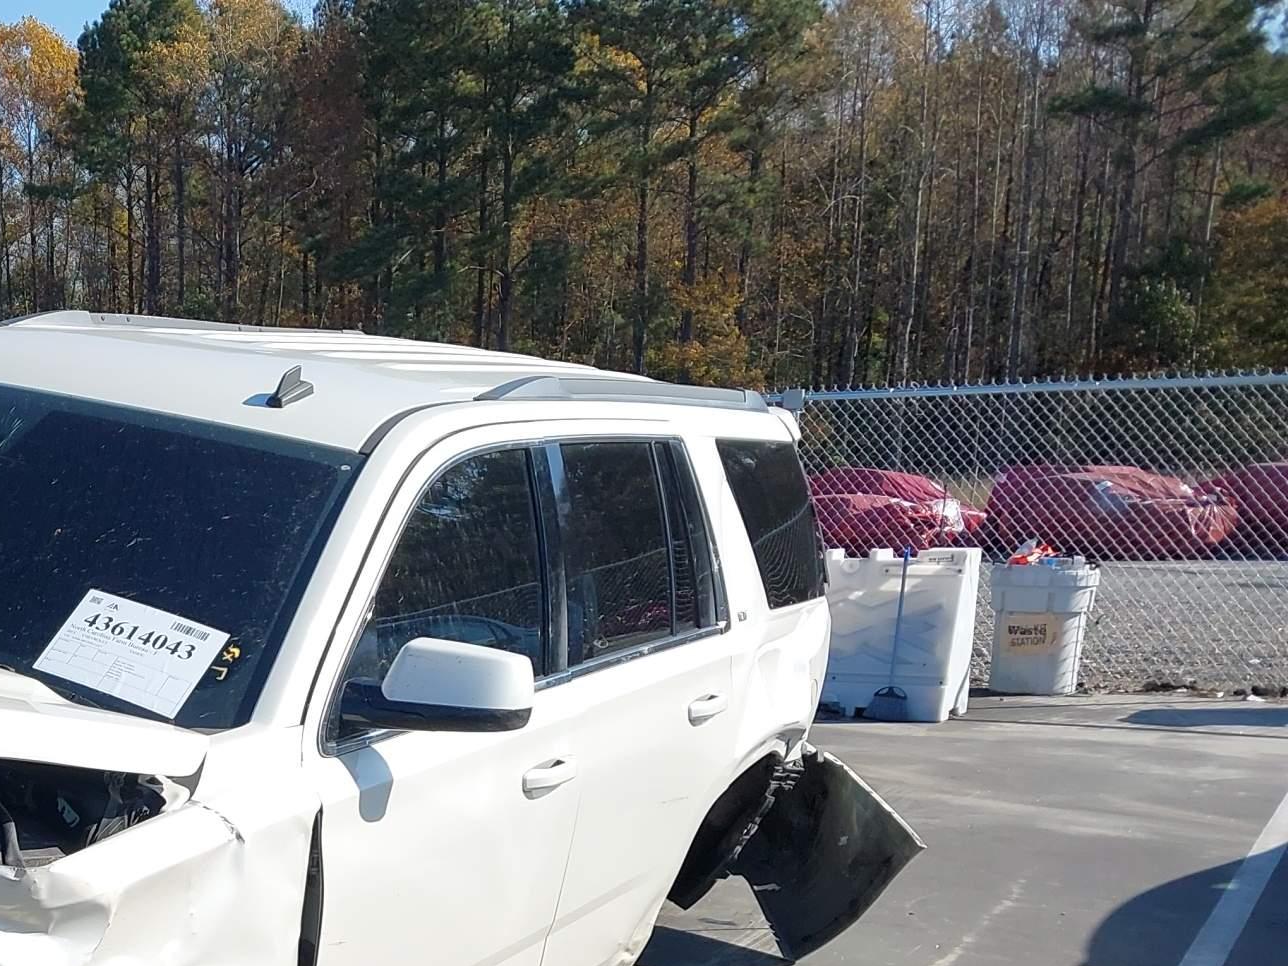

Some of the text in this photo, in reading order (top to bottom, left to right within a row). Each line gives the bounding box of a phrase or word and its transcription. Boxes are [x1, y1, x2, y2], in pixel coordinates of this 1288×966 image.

[1008, 623, 1047, 636] Waste
[84, 613, 196, 660] 43614043
[1009, 635, 1046, 647] STATION
